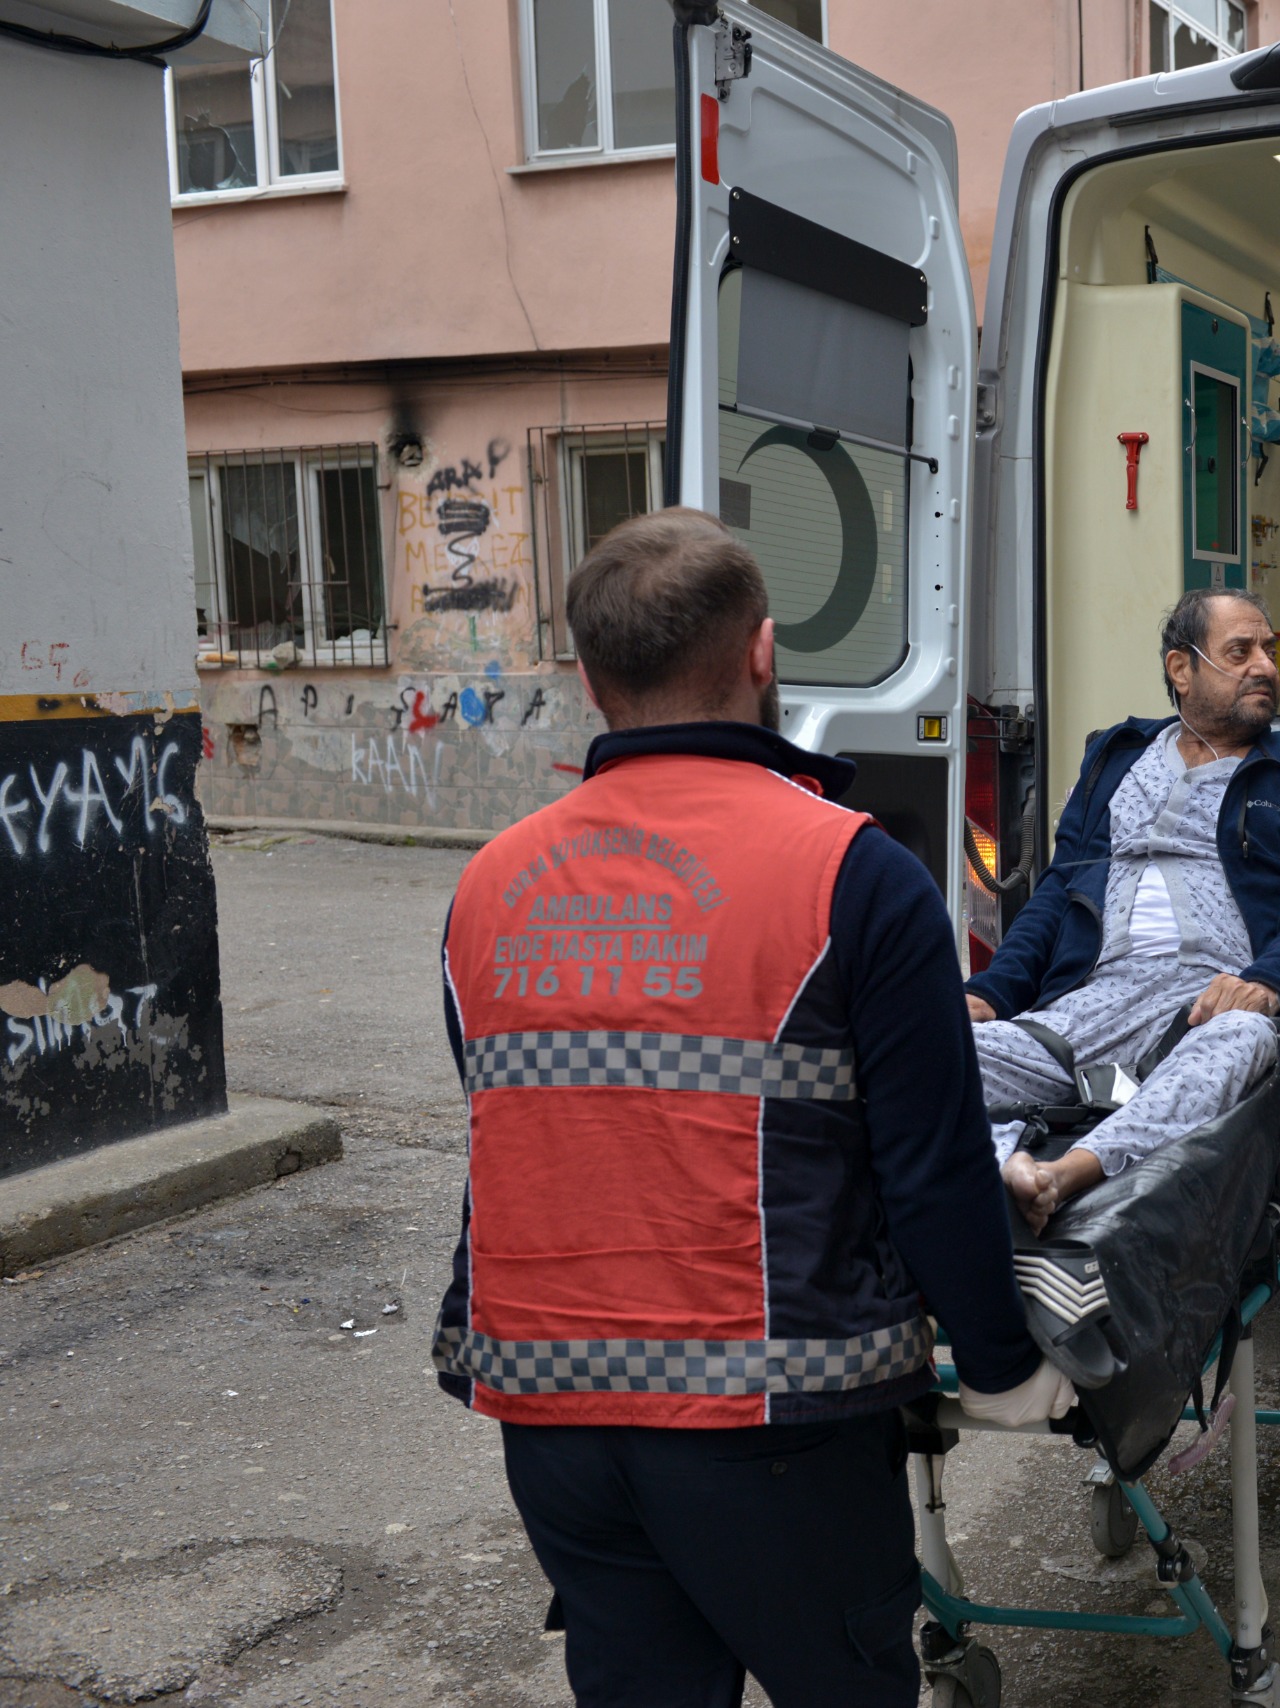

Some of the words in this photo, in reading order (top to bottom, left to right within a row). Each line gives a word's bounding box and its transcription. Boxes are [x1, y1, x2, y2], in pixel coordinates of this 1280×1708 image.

[502, 854, 549, 909] BURSA
[550, 821, 646, 870] BÜYÜKŞEHİR
[645, 832, 731, 913] BELEDİYESİ
[527, 893, 673, 922] AMBULANS
[493, 934, 545, 963] EVDE
[550, 934, 623, 962] HASTA
[630, 933, 708, 963] BAKIM
[493, 964, 560, 999] 716
[642, 965, 704, 999] 55
